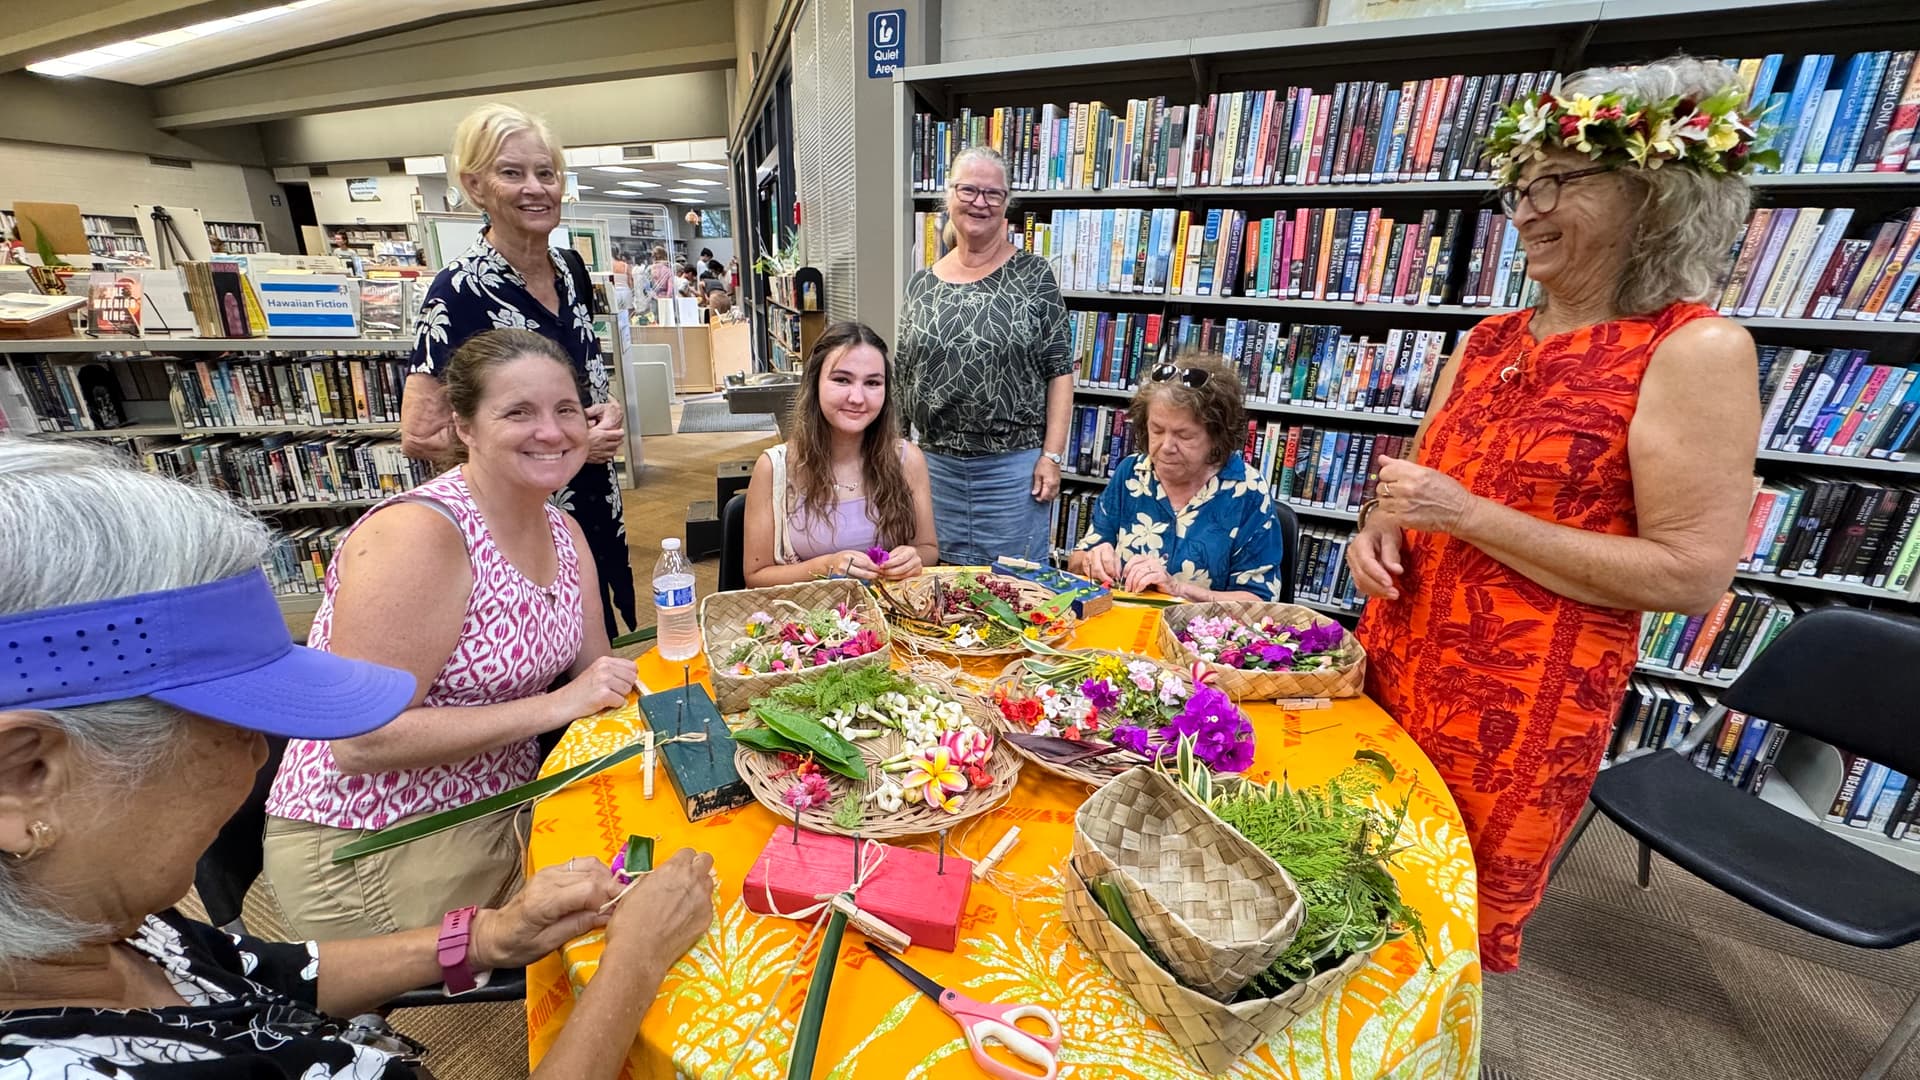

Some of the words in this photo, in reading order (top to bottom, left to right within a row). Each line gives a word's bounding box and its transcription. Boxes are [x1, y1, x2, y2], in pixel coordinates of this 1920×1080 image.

[874, 49, 899, 61] Quiet
[1873, 69, 1906, 129] BABYLONIA
[1025, 216, 1033, 230] TOM
[1024, 230, 1032, 253] CLANC
[1350, 216, 1366, 255] ORIENT
[1336, 249, 1344, 274] CHRIS
[268, 299, 314, 308] Hawaiian
[316, 300, 348, 309] Fiction
[1244, 335, 1254, 365] BADLANDS
[1402, 332, 1413, 350] C.J.
[1399, 350, 1410, 368] BOX
[1412, 351, 1422, 371] BOX
[1425, 353, 1435, 374] BOX
[1782, 362, 1802, 390] SWIPED
[1350, 438, 1360, 451] DALE
[1363, 439, 1373, 452] DALE
[1346, 453, 1356, 472] BROWN
[1359, 454, 1369, 474] BROWN
[1907, 497, 1920, 513] HER
[1895, 515, 1913, 538] MANY
[1310, 542, 1320, 559] NINE
[1882, 540, 1901, 566] FACES
[1306, 560, 1315, 576] ELMS
[1849, 757, 1868, 775] FERY
